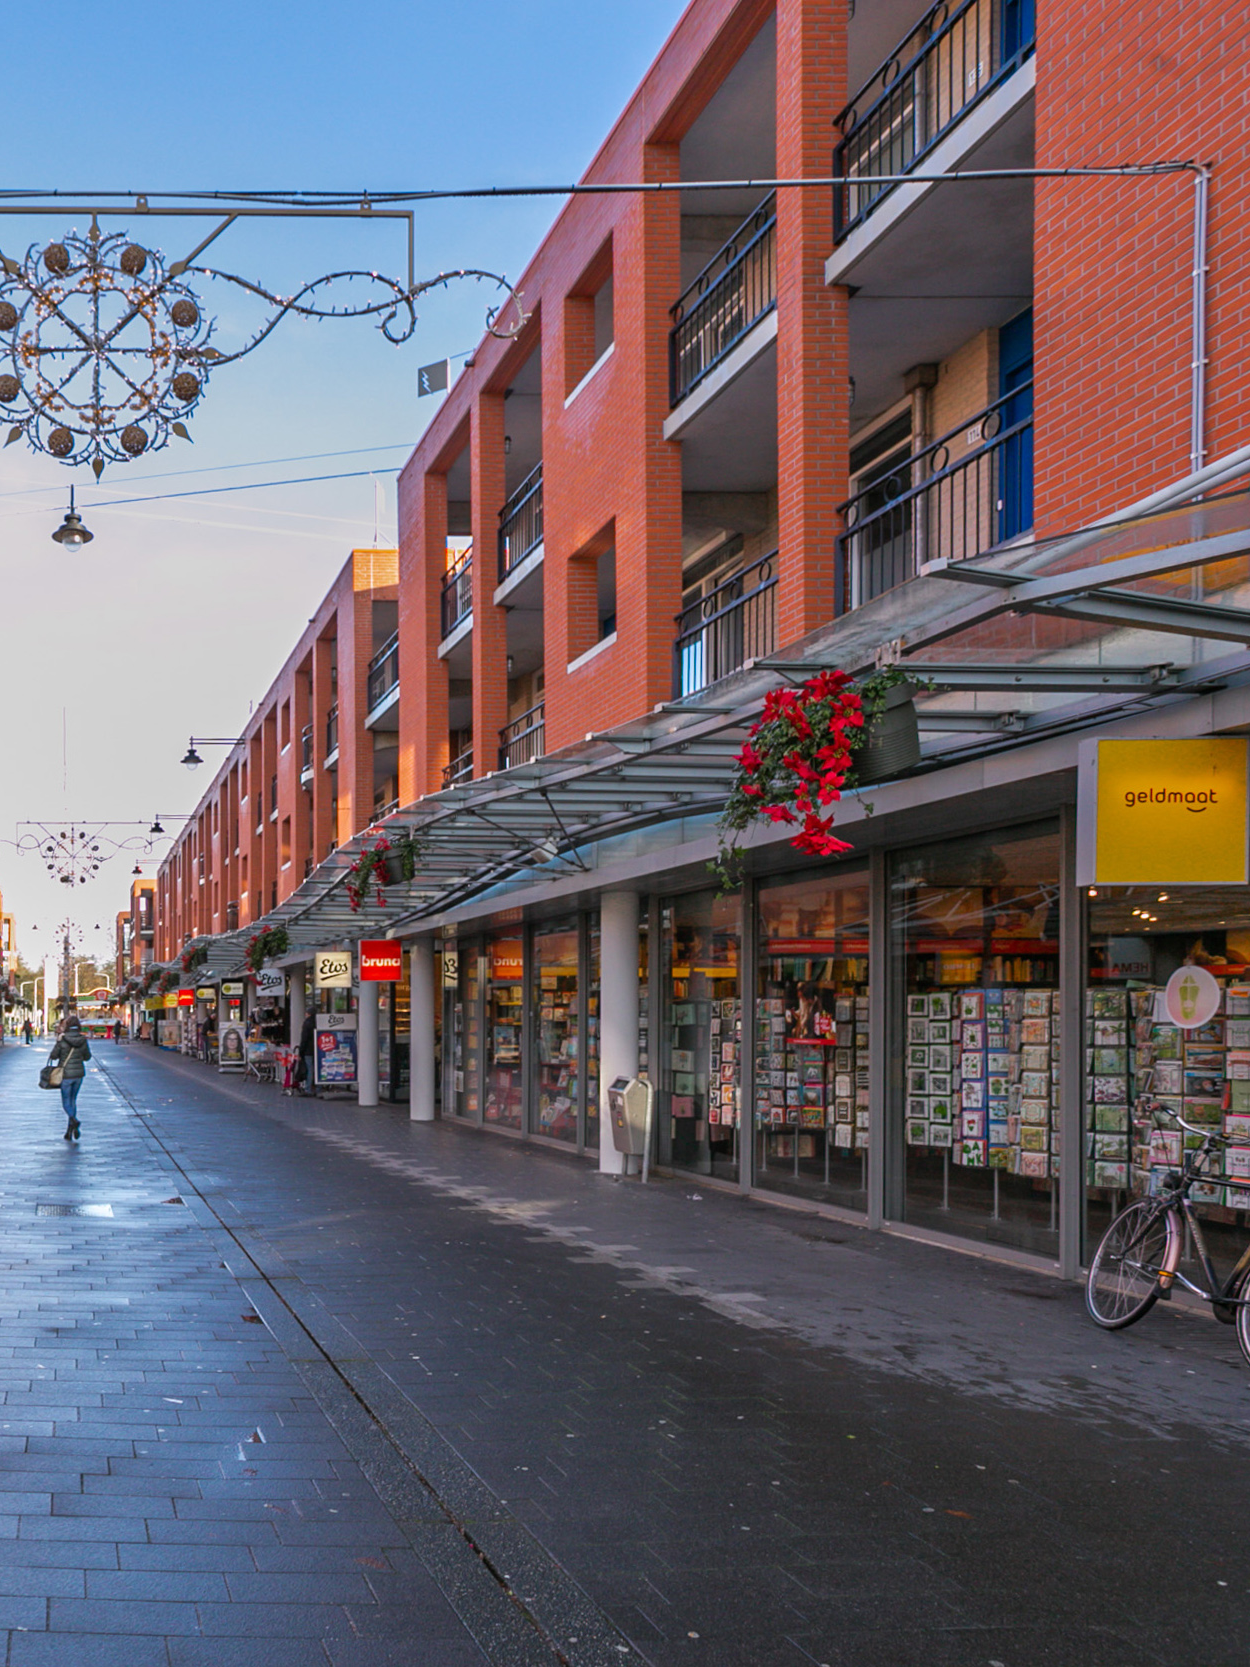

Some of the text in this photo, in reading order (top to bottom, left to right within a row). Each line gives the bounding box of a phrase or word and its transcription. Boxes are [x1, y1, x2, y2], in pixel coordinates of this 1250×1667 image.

[1125, 788, 1218, 807] geldmaat
[320, 959, 349, 974] Etos
[362, 955, 401, 967] bruna
[327, 1014, 345, 1024] Etos
